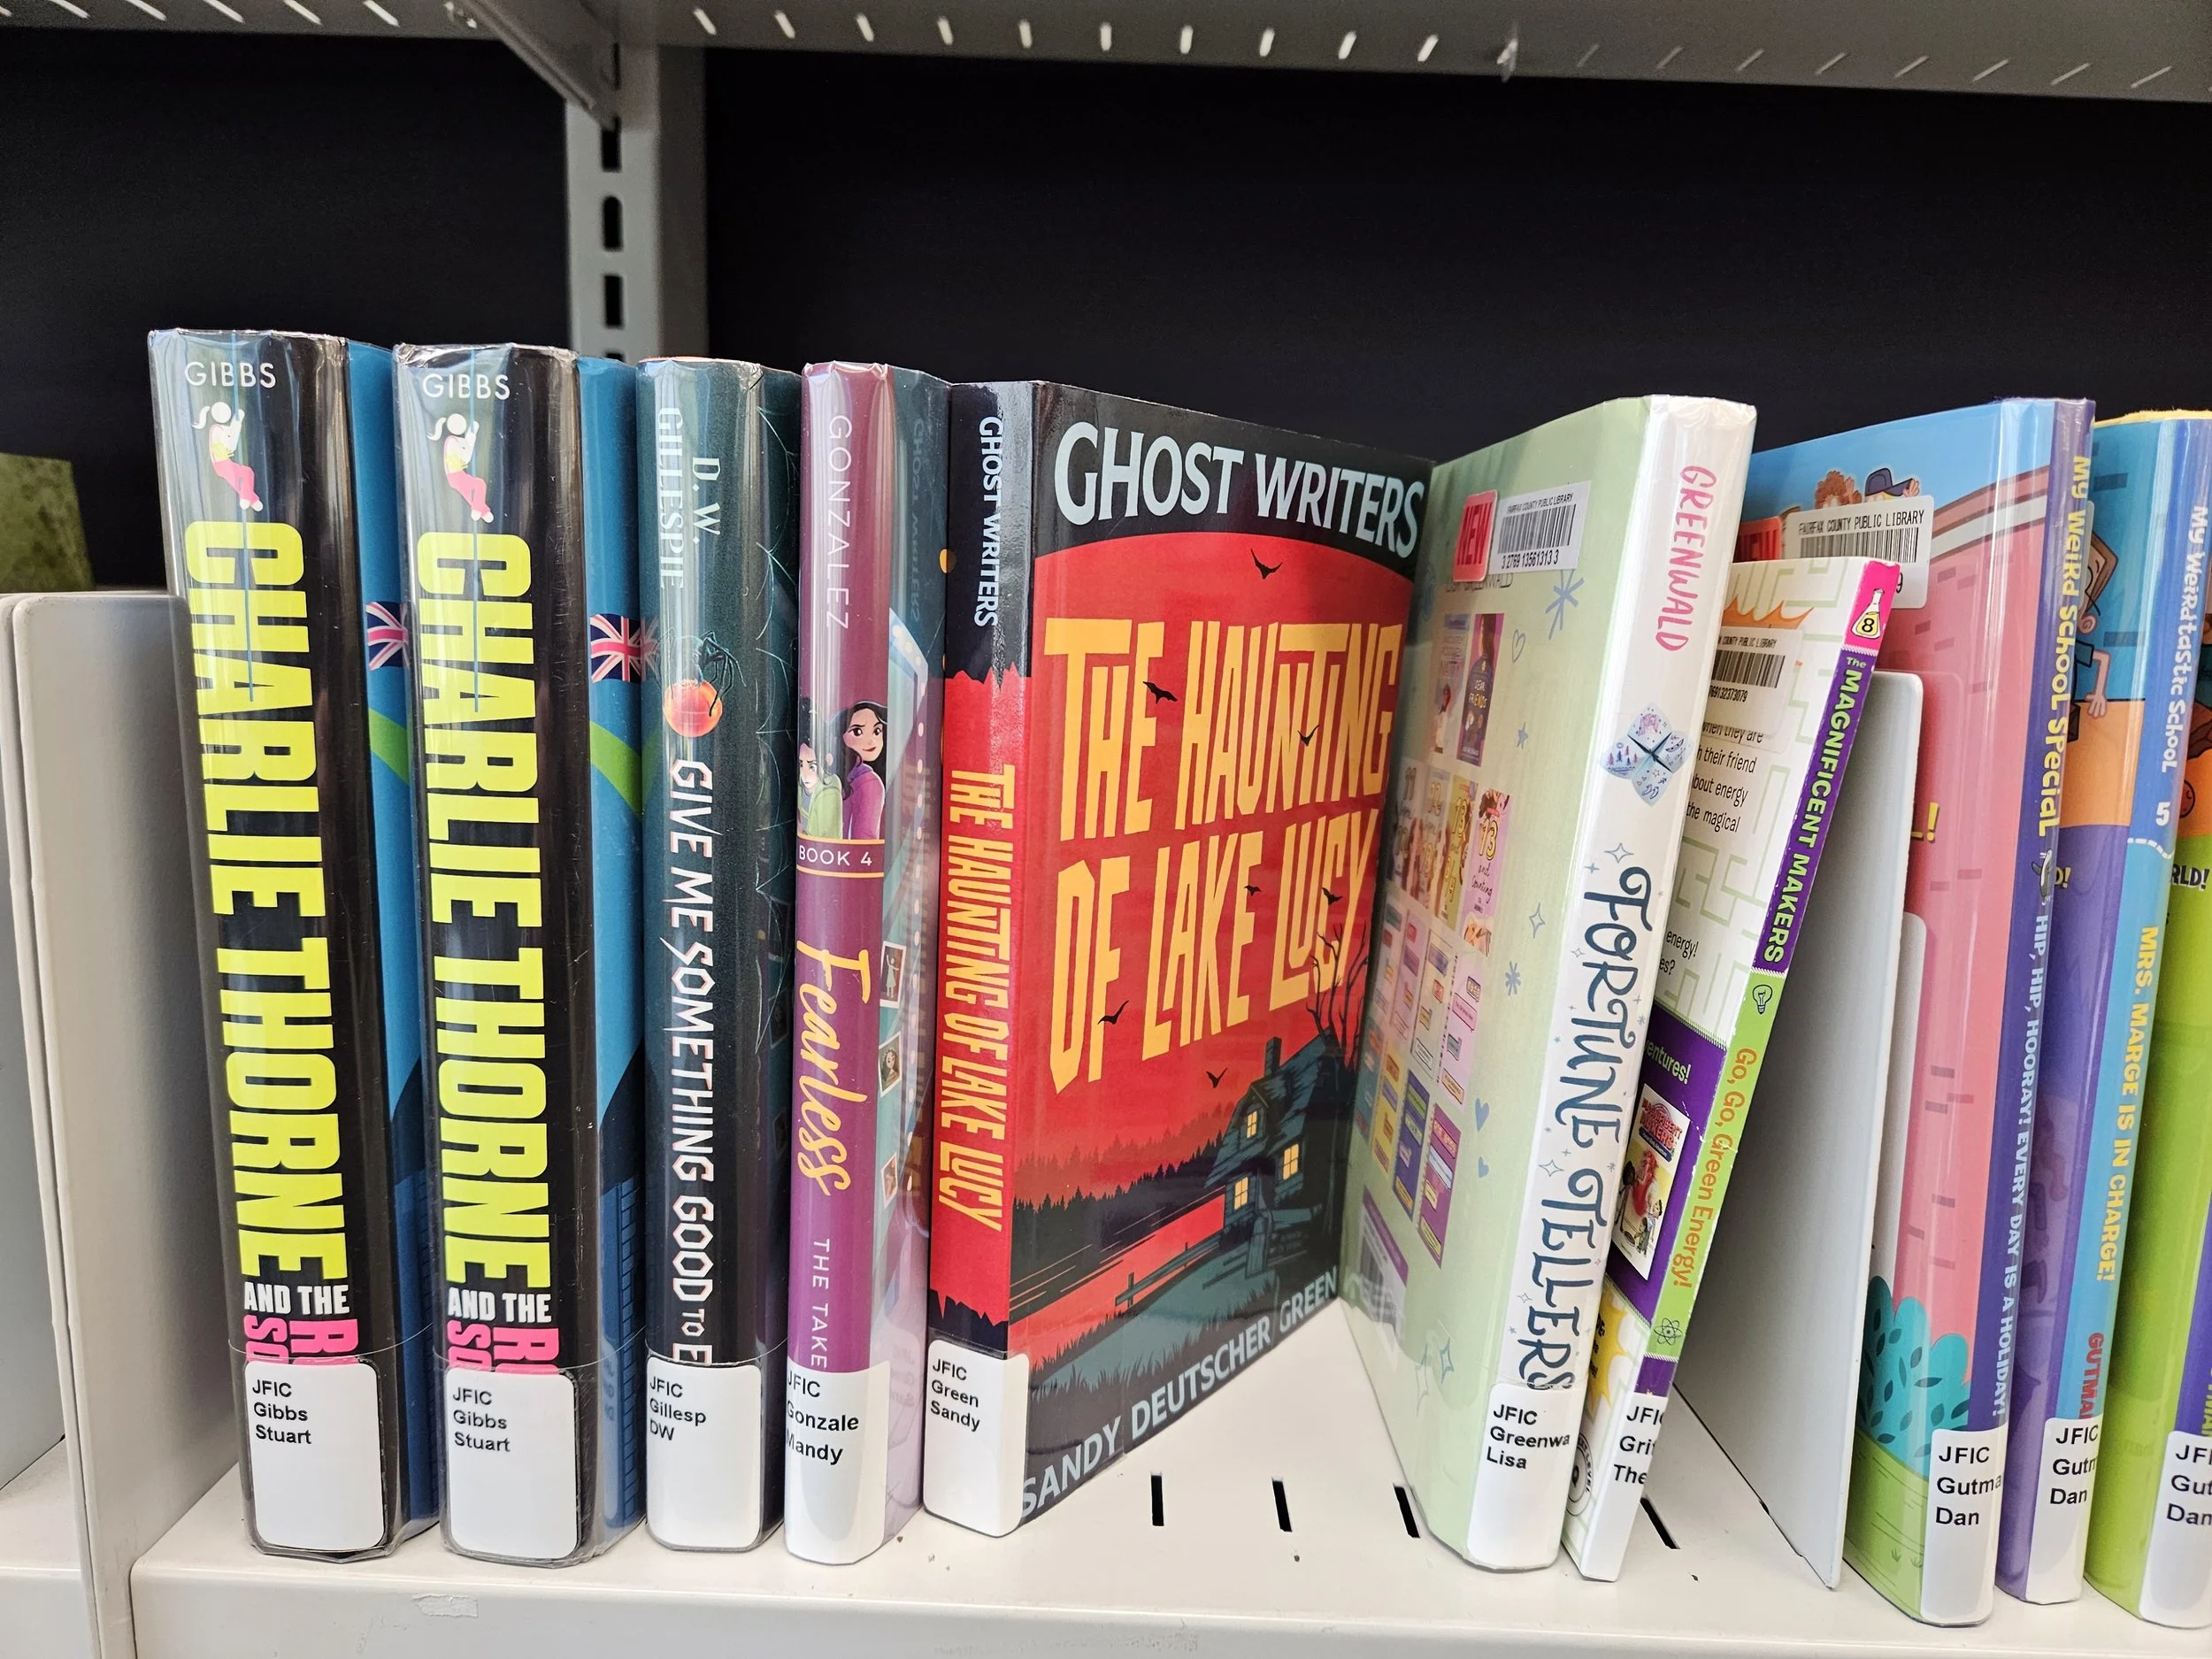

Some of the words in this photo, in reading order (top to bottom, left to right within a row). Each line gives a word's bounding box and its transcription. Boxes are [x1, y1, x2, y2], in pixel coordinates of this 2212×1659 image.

[185, 361, 277, 388] GIBBS
[422, 373, 511, 400] GIBBS
[692, 457, 720, 493] D.
[978, 415, 1004, 502] GHOST
[2070, 455, 2092, 500] My
[657, 406, 685, 590] GILLESPIE
[1053, 421, 1243, 526] GHOST
[1254, 452, 1425, 559] WRITERS
[1522, 501, 1538, 511] COUNTY
[1538, 497, 1553, 508] PUBLIC
[1553, 492, 1574, 505] LIBRARY
[692, 502, 721, 545] W.
[826, 413, 853, 631] GONZALEZ
[1456, 502, 1493, 566] NEW
[1799, 519, 1824, 533] FAIRFAX
[1826, 517, 1853, 532] COUNTY
[1854, 513, 1882, 529] PUBLIC
[1886, 510, 1924, 527] LIBRARY
[2187, 504, 2209, 545] My
[973, 507, 1002, 628] WRITERS
[1553, 549, 1560, 565] 3
[1655, 465, 1717, 652] GREENWALD
[1861, 617, 1875, 634] 8
[1846, 656, 1868, 669] The
[183, 520, 326, 918] CHARLIE
[416, 531, 543, 928] CHARLIE
[1043, 617, 1165, 842] THE
[1173, 618, 1403, 832] HAUNTING
[1703, 746, 1726, 765] their
[1726, 750, 1758, 773] friend
[1798, 669, 1863, 849] MAGNIFICENT
[949, 764, 1016, 830] THE
[1691, 773, 1715, 794] bout
[1715, 782, 1749, 807] energy
[669, 760, 724, 872] GIVE
[1686, 801, 1701, 819] the
[1702, 810, 1741, 833] magical
[2155, 802, 2170, 827] 5
[799, 845, 850, 866] BOOK
[860, 851, 872, 866] 4
[1478, 817, 1499, 861] 13
[660, 878, 714, 932] ME
[943, 836, 1014, 1009] HAUNTING
[1764, 852, 1810, 964] MAKERS
[1048, 855, 1130, 1095] OF
[1141, 830, 1264, 1062] LAKE
[1268, 808, 1381, 1012] LUCY
[1665, 930, 1699, 960] energy!
[2028, 914, 2049, 961] HIP,
[2134, 926, 2160, 995] MRS.
[1558, 864, 1655, 1151] FORTUNE
[2024, 966, 2045, 1013] HIP,
[941, 1010, 1010, 1054] OF
[2122, 1002, 2150, 1096] MARGE
[658, 937, 716, 1183] SOMETHING
[795, 938, 871, 1198] Fearless
[1645, 1040, 1692, 1085] entures!
[1726, 1047, 1757, 1085] Go,
[2017, 1018, 2040, 1125] HOORAY!
[217, 935, 349, 1280] THORNE
[939, 1052, 1009, 1141] LAKE
[1714, 1090, 1746, 1128] Go,
[432, 947, 552, 1288] THORNE
[2116, 1103, 2137, 1132] IS
[1697, 1133, 1733, 1201] Green
[2011, 1130, 2030, 1210] EVERY
[2111, 1138, 2132, 1168] IN
[937, 1141, 1006, 1233] LUCY
[1671, 1203, 1714, 1289] Energy!
[2006, 1213, 2024, 1257] DAY
[2095, 1173, 2127, 1283] CHARGE!
[672, 1195, 715, 1302] GOOD
[810, 1237, 832, 1290] THE
[1518, 1167, 1609, 1391] TELLERS
[2003, 1265, 2017, 1290] IS
[243, 1280, 292, 1315] AND
[296, 1284, 350, 1316] THE
[447, 1286, 496, 1321] AND
[501, 1292, 552, 1324] THE
[2001, 1295, 2015, 1313] A
[680, 1308, 706, 1337] TO
[810, 1302, 830, 1369] TAKE
[787, 1370, 821, 1398] JFIC
[932, 1357, 968, 1382] JFIC
[1992, 1316, 2015, 1417] HOLIDAY!
[2078, 1332, 2105, 1419] GUTMA
[251, 1379, 292, 1398] JFIC
[452, 1386, 493, 1405] JFIC
[649, 1375, 683, 1398] JFIC
[931, 1378, 980, 1409] Green
[1023, 1415, 1123, 1518] SANDY
[1131, 1315, 1272, 1440] DEUTSCHER
[1279, 1264, 1338, 1333] GREEN
[253, 1402, 309, 1422] Gibbs
[453, 1409, 508, 1430] Gibbs
[649, 1397, 707, 1426] Gillesp
[649, 1419, 674, 1441] DW
[787, 1399, 860, 1432] Gonzale
[929, 1400, 981, 1433] Sandy
[1493, 1403, 1539, 1426] JFIC
[255, 1424, 312, 1445] Stuart
[454, 1431, 511, 1452] Stuart
[787, 1427, 844, 1465] Mandy
[1489, 1425, 1571, 1448] Greenwa
[1619, 1435, 1655, 1455] Gri
[2055, 1424, 2099, 1445] JFIC
[1486, 1445, 1528, 1470] Lisa
[1613, 1463, 1647, 1485] The
[1938, 1446, 1990, 1464] JFIC
[1936, 1474, 2002, 1495] Gutma
[2049, 1486, 2088, 1505] Dan
[1935, 1506, 1980, 1526] Dan
